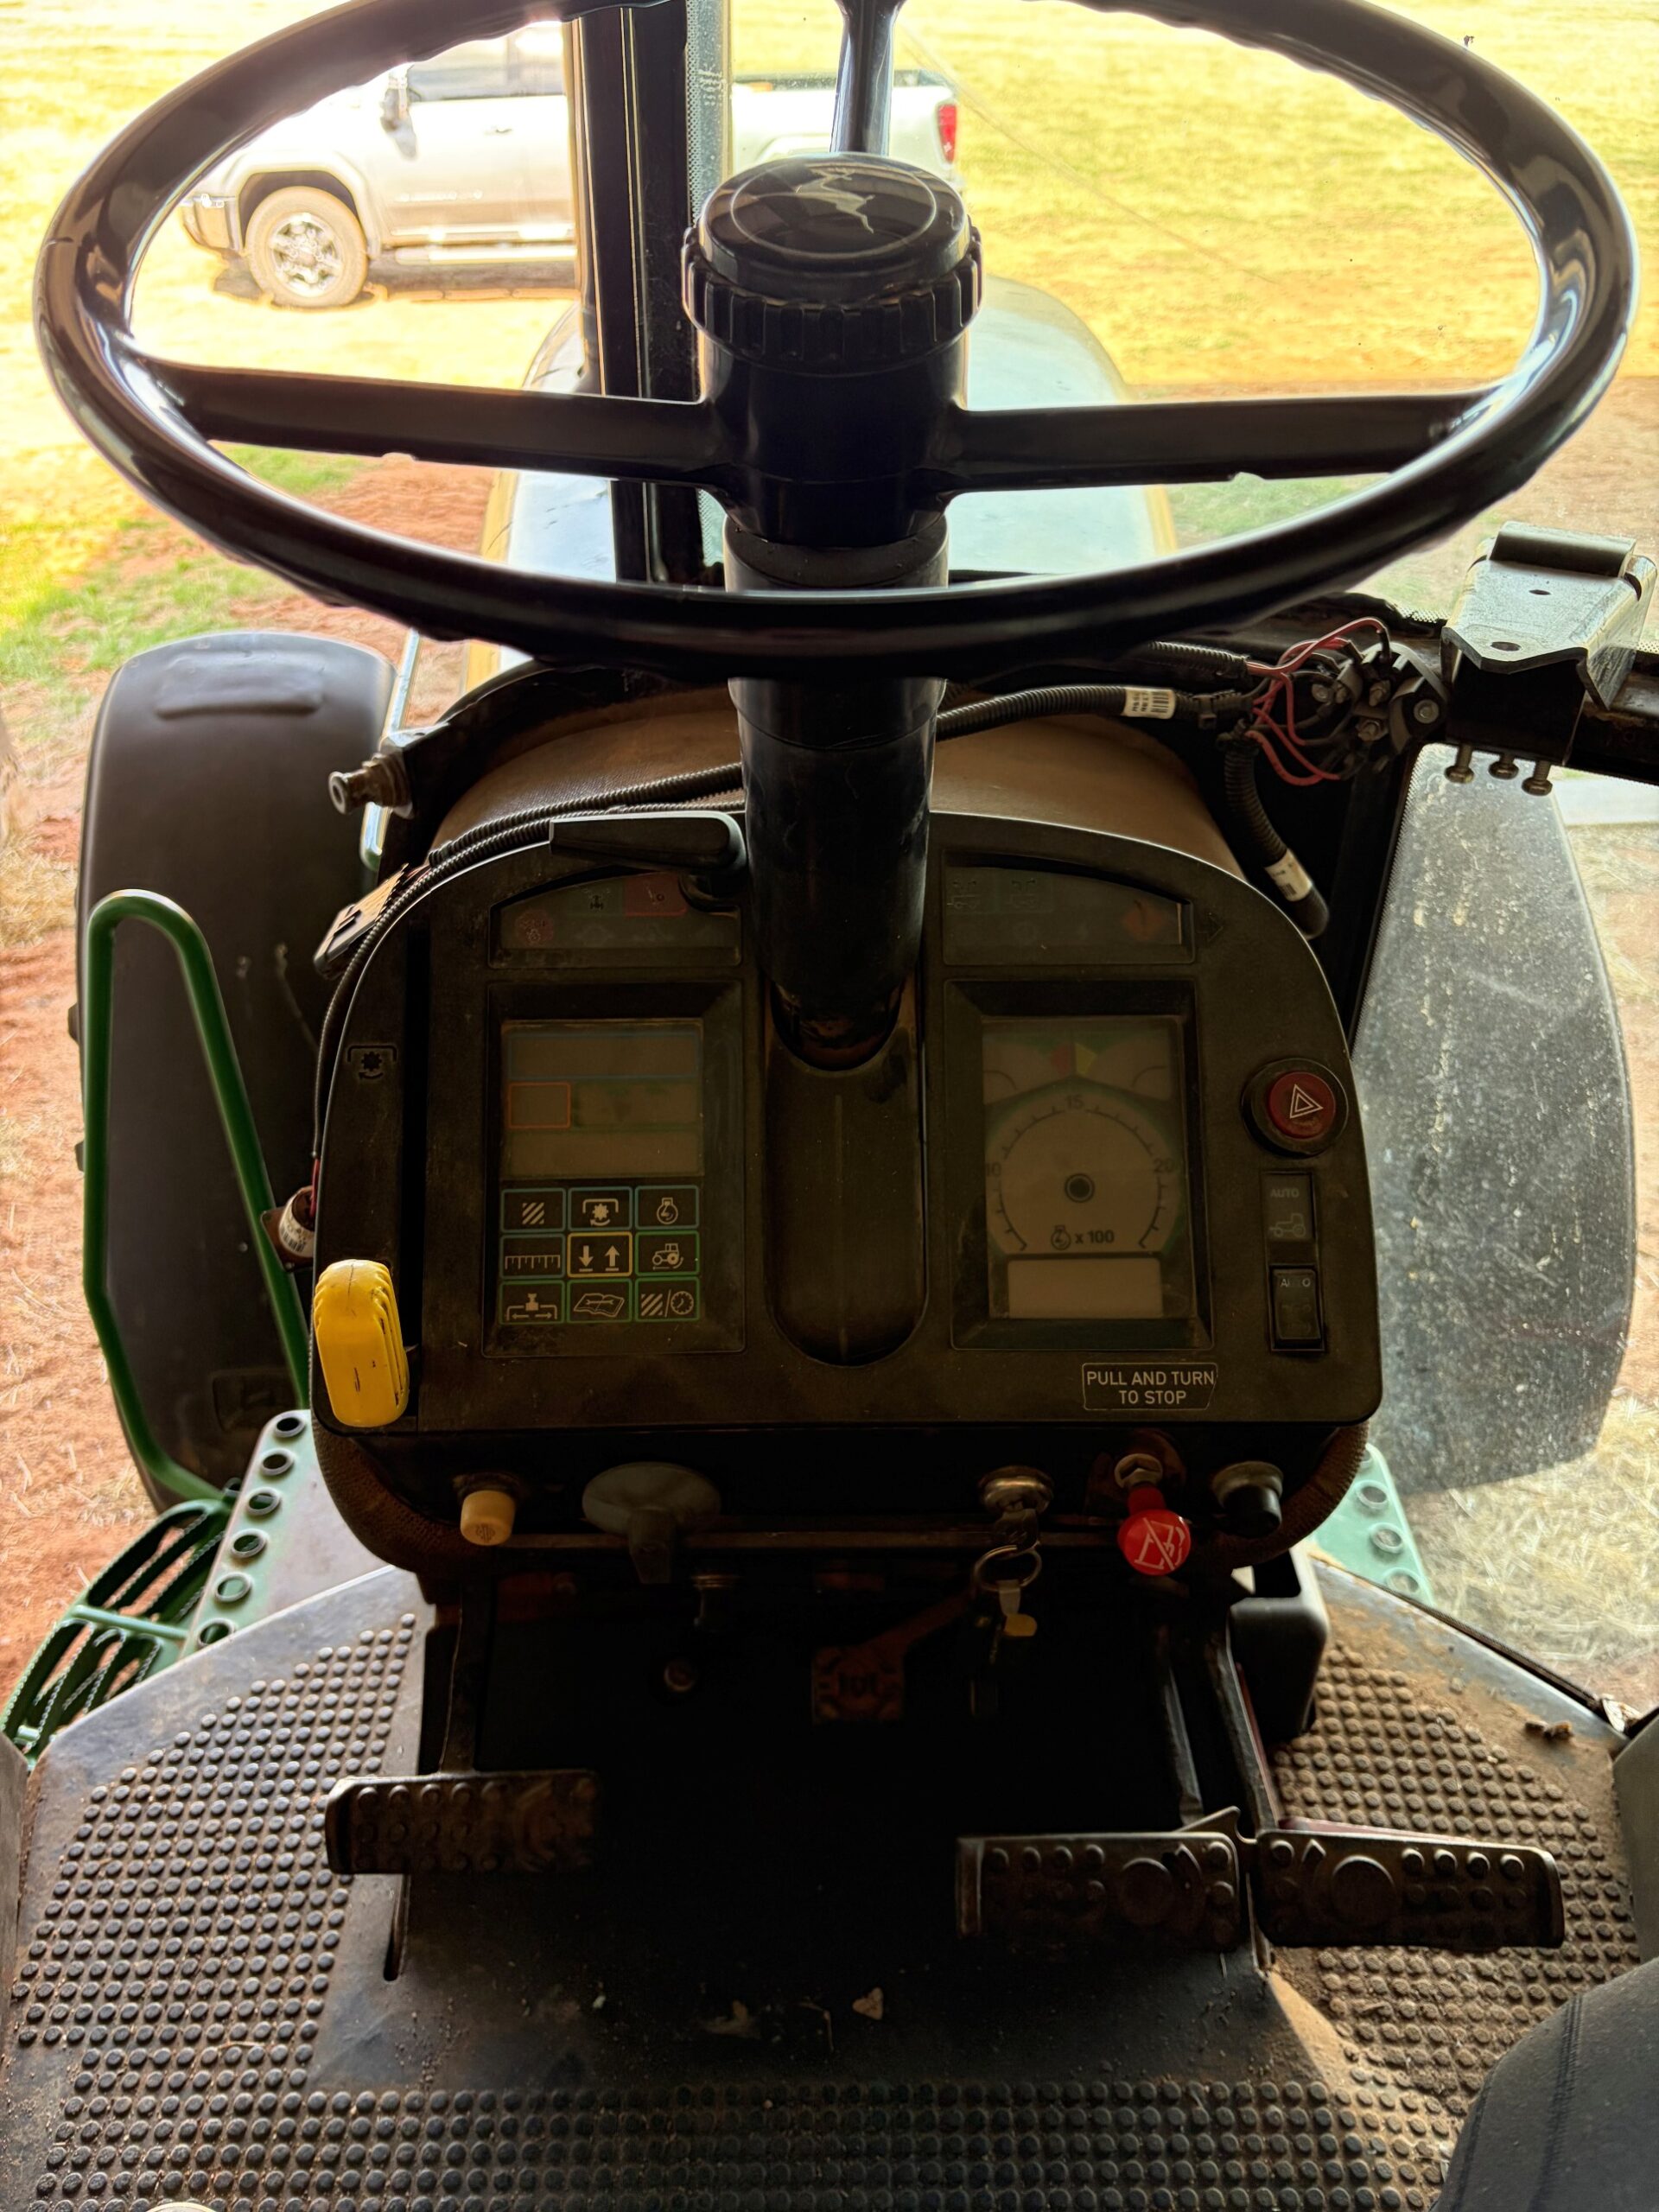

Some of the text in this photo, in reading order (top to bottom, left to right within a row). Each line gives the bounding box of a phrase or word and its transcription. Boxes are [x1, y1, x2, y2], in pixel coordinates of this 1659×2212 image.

[1066, 1095, 1084, 1109] 15
[1270, 1188, 1300, 1198] AUTO
[1088, 1230, 1115, 1244] 100
[1280, 1278, 1311, 1288] AO
[1087, 1370, 1214, 1386] PULL AND TURN
[1118, 1389, 1187, 1405] TO STOP
